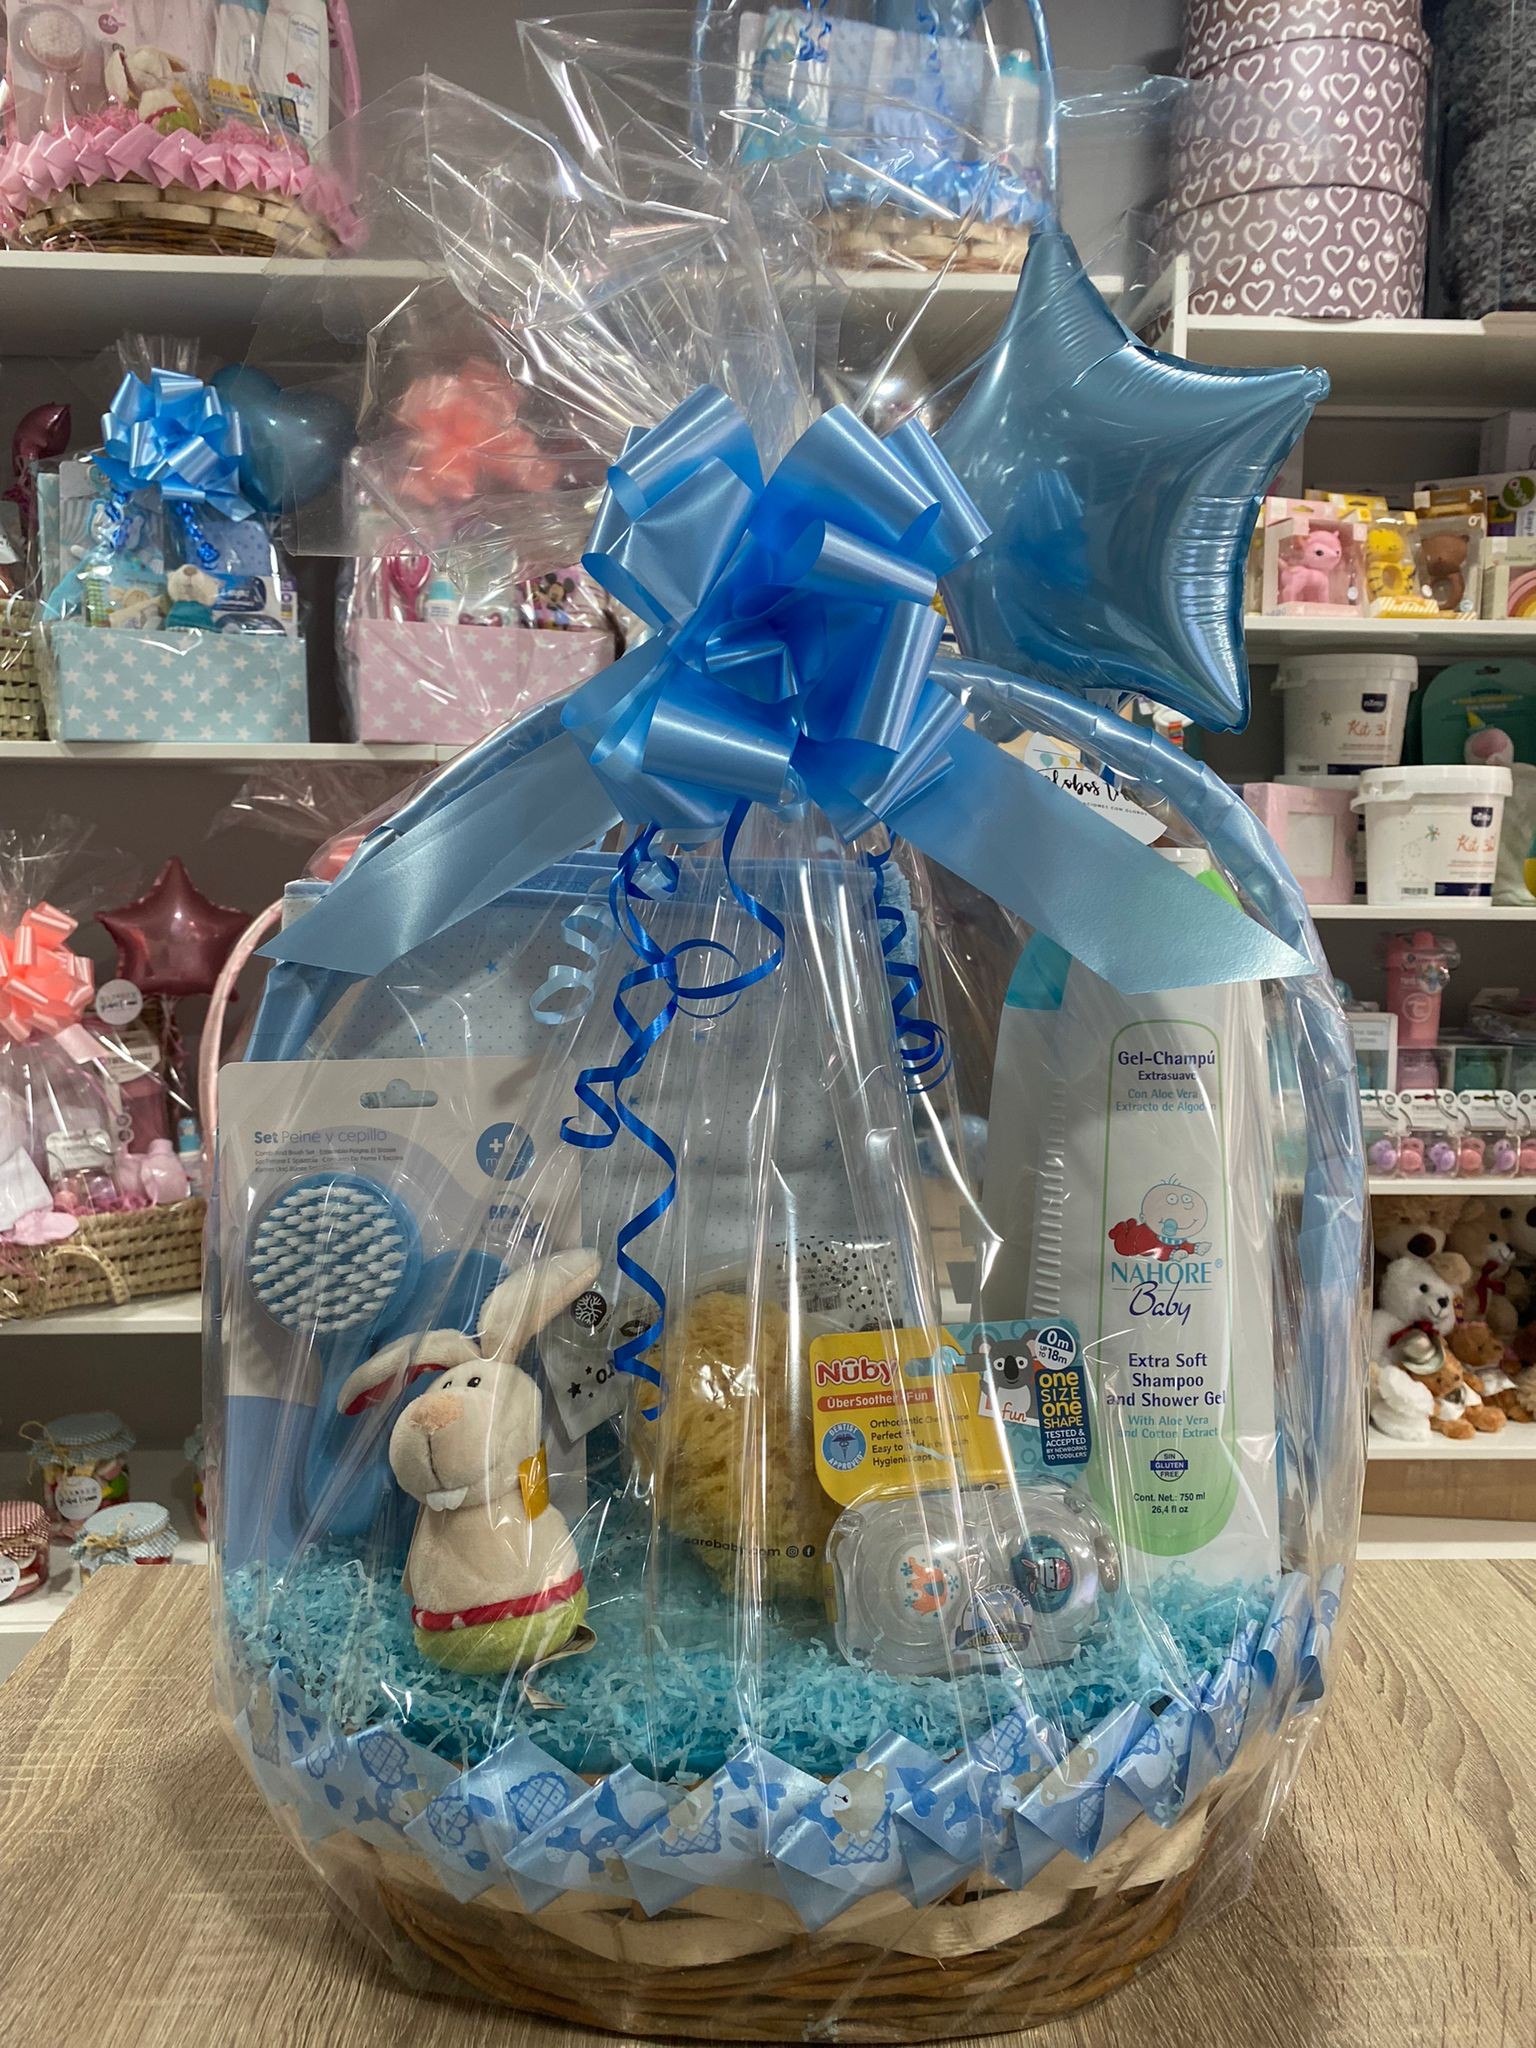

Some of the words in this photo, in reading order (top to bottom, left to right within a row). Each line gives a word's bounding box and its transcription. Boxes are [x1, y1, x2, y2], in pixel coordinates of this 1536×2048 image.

[1117, 1050, 1216, 1068] Gel-Champú
[1127, 1088, 1148, 1099] Con
[1151, 1088, 1174, 1099] Aloe
[1176, 1088, 1198, 1099] Vera
[1116, 1101, 1159, 1111] Extracto
[1162, 1101, 1175, 1111] de
[1177, 1101, 1217, 1114] Algodn
[254, 1131, 278, 1144] Set
[281, 1130, 321, 1143] Peine
[324, 1132, 334, 1144] y
[337, 1128, 388, 1145] cepillo
[1111, 1261, 1213, 1285] NAHORE
[1129, 1280, 1191, 1326] Baby
[1128, 1353, 1170, 1368] Extra
[1176, 1352, 1208, 1368] Soft
[1039, 1371, 1079, 1388] one
[1132, 1372, 1204, 1391] Shampoo
[1041, 1387, 1081, 1402] SIZE
[1106, 1393, 1136, 1407] and
[1141, 1392, 1200, 1407] Shower
[1204, 1391, 1227, 1405] Gel
[1002, 1401, 1027, 1422] fun
[1042, 1400, 1082, 1417] one
[1044, 1416, 1084, 1429] SHAPE
[1128, 1415, 1153, 1426] With
[1158, 1415, 1183, 1426] Aloe
[1186, 1415, 1209, 1426] Vera
[829, 1423, 859, 1437] DENTIST
[871, 1431, 903, 1441] Perfect
[1045, 1430, 1077, 1440] TESTED
[1078, 1428, 1086, 1437] &
[1118, 1428, 1138, 1439] and
[1142, 1429, 1178, 1439] Cotton
[1182, 1427, 1218, 1439] Extract
[1046, 1437, 1087, 1448] ACCEPTED
[872, 1445, 892, 1454] Easy
[894, 1444, 904, 1452] to
[913, 1454, 932, 1464] caps
[1047, 1453, 1056, 1461] TO
[1057, 1451, 1088, 1460] TODDLERS
[1163, 1453, 1176, 1461] SIN
[1154, 1461, 1184, 1470] GLUTEN
[1160, 1471, 1179, 1479] FREE
[1134, 1492, 1156, 1502] Cont.
[1180, 1492, 1195, 1502] 750
[1196, 1492, 1206, 1501] ml
[1152, 1505, 1170, 1515] 26,4
